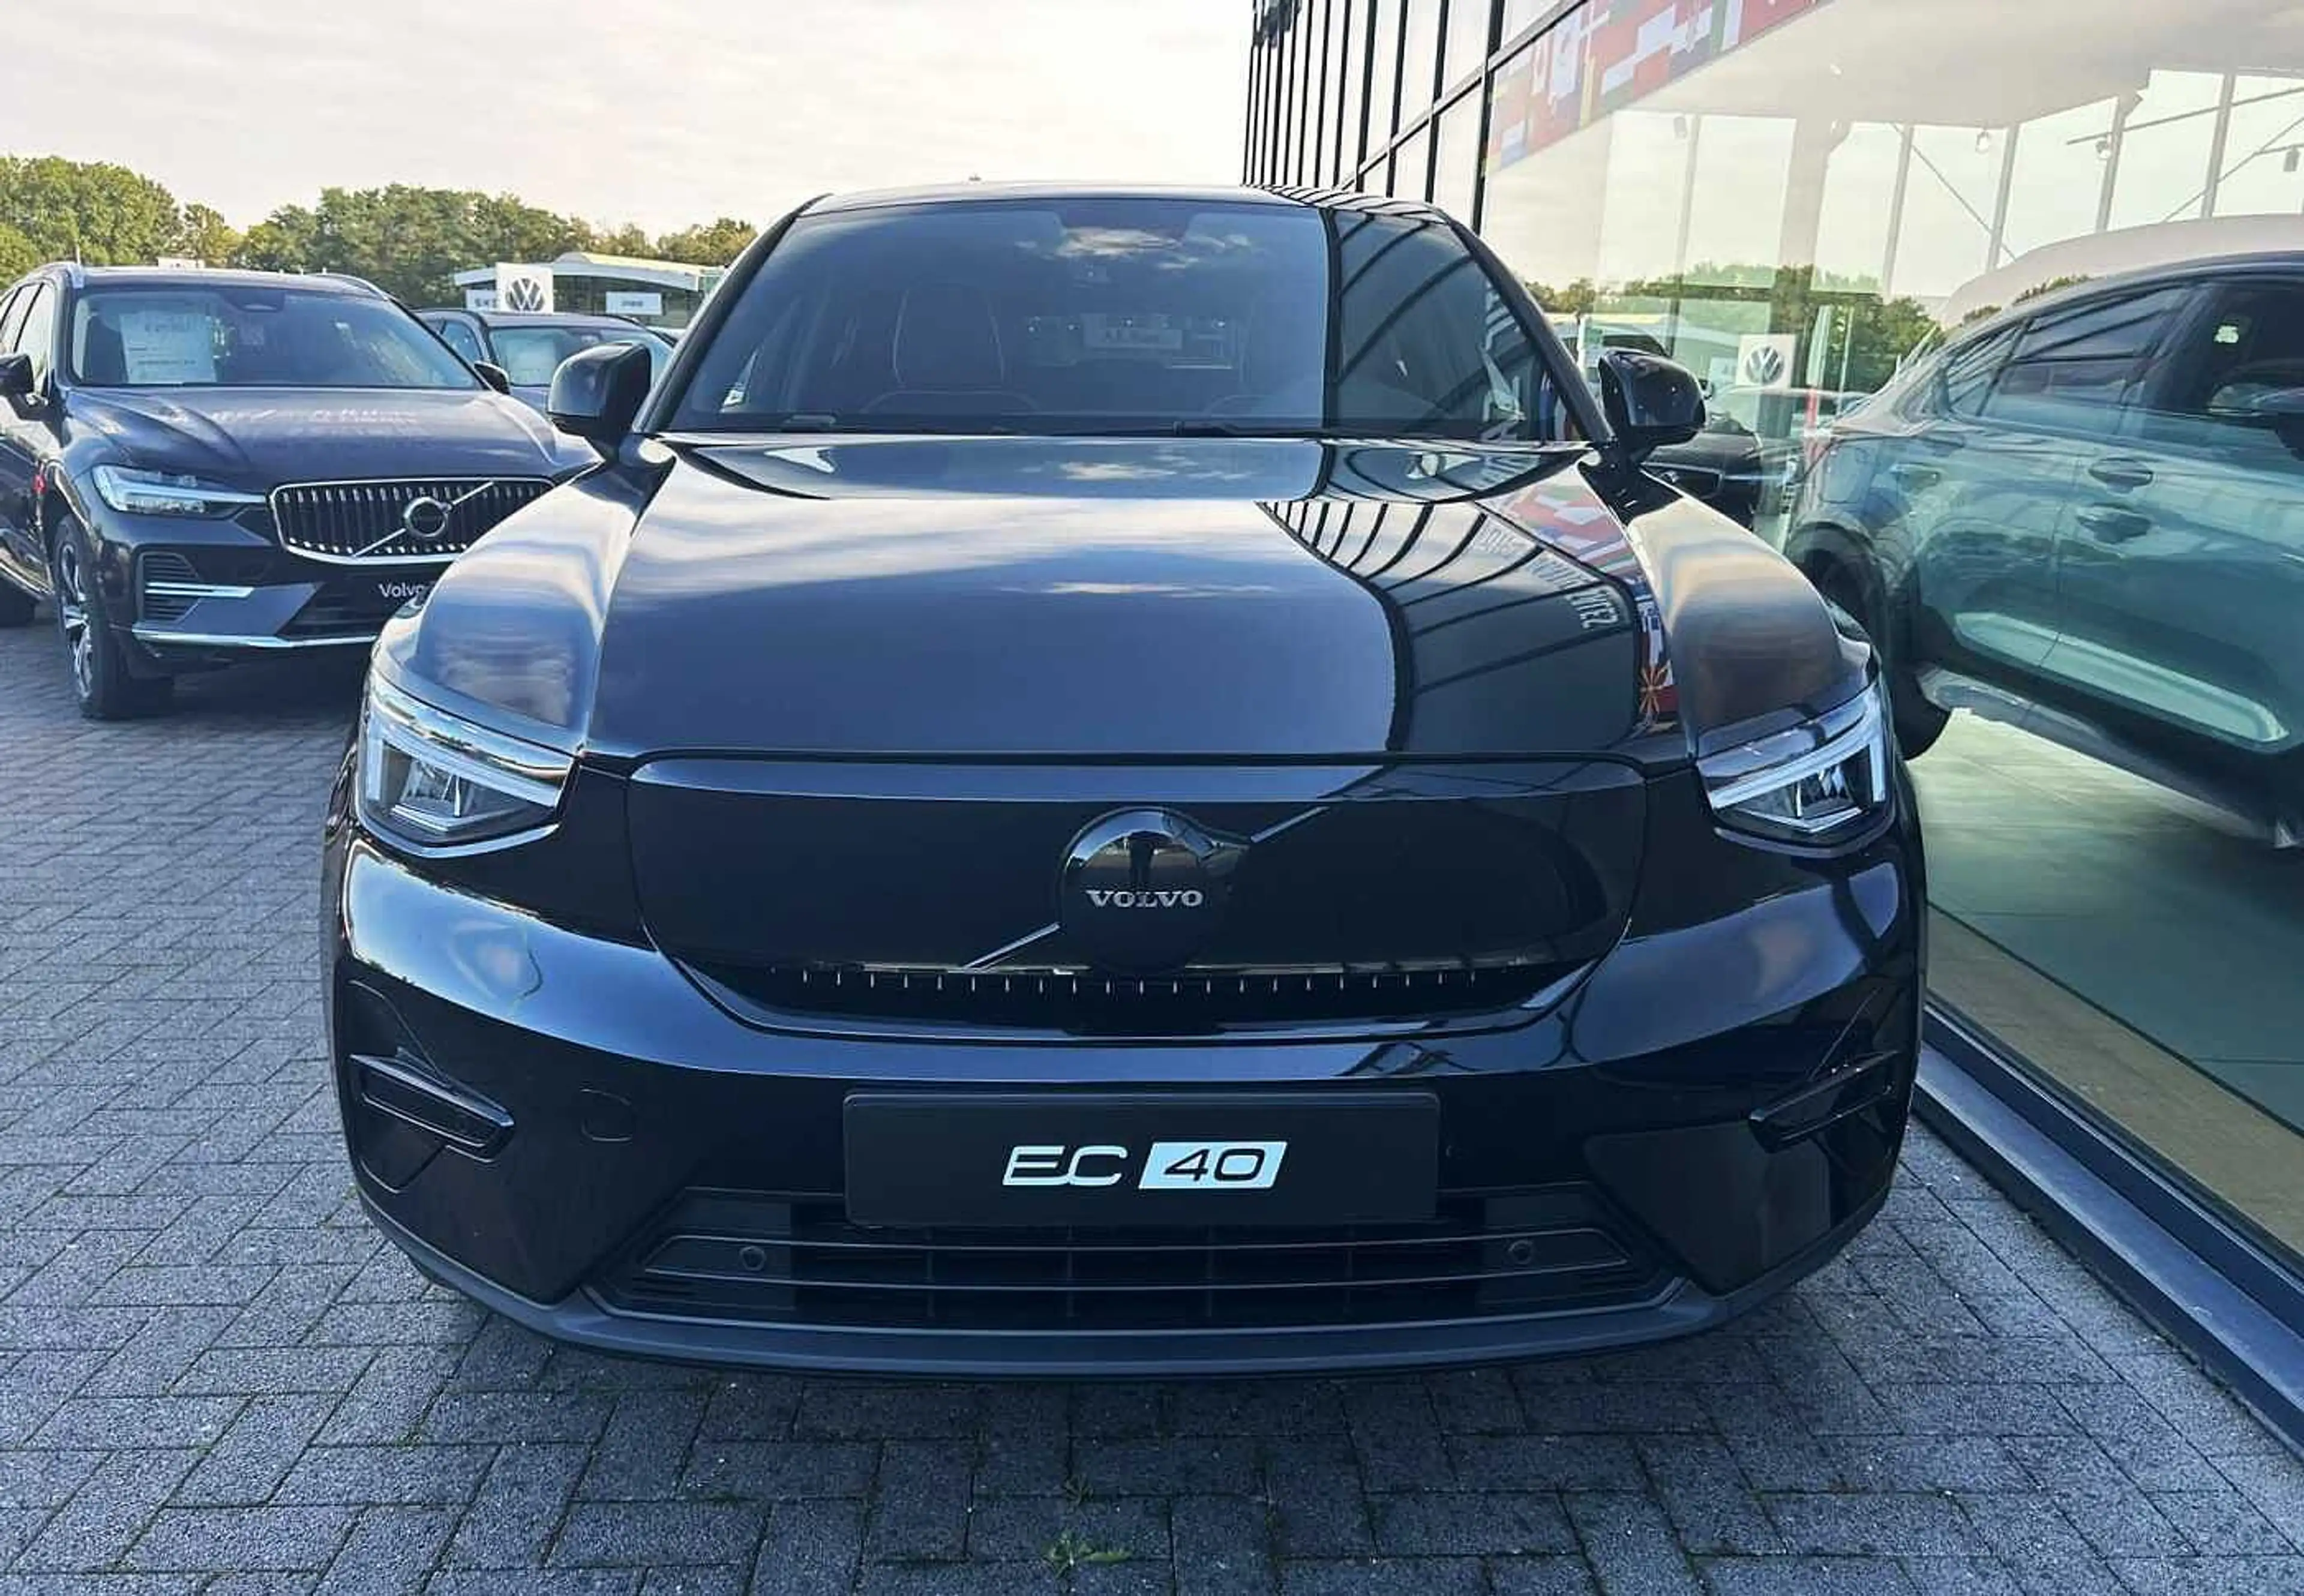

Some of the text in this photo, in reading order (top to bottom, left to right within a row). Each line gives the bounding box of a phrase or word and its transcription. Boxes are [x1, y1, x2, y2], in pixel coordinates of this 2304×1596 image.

[1085, 890, 1203, 908] VOLVO
[1002, 1145, 1266, 1186] EC 40
